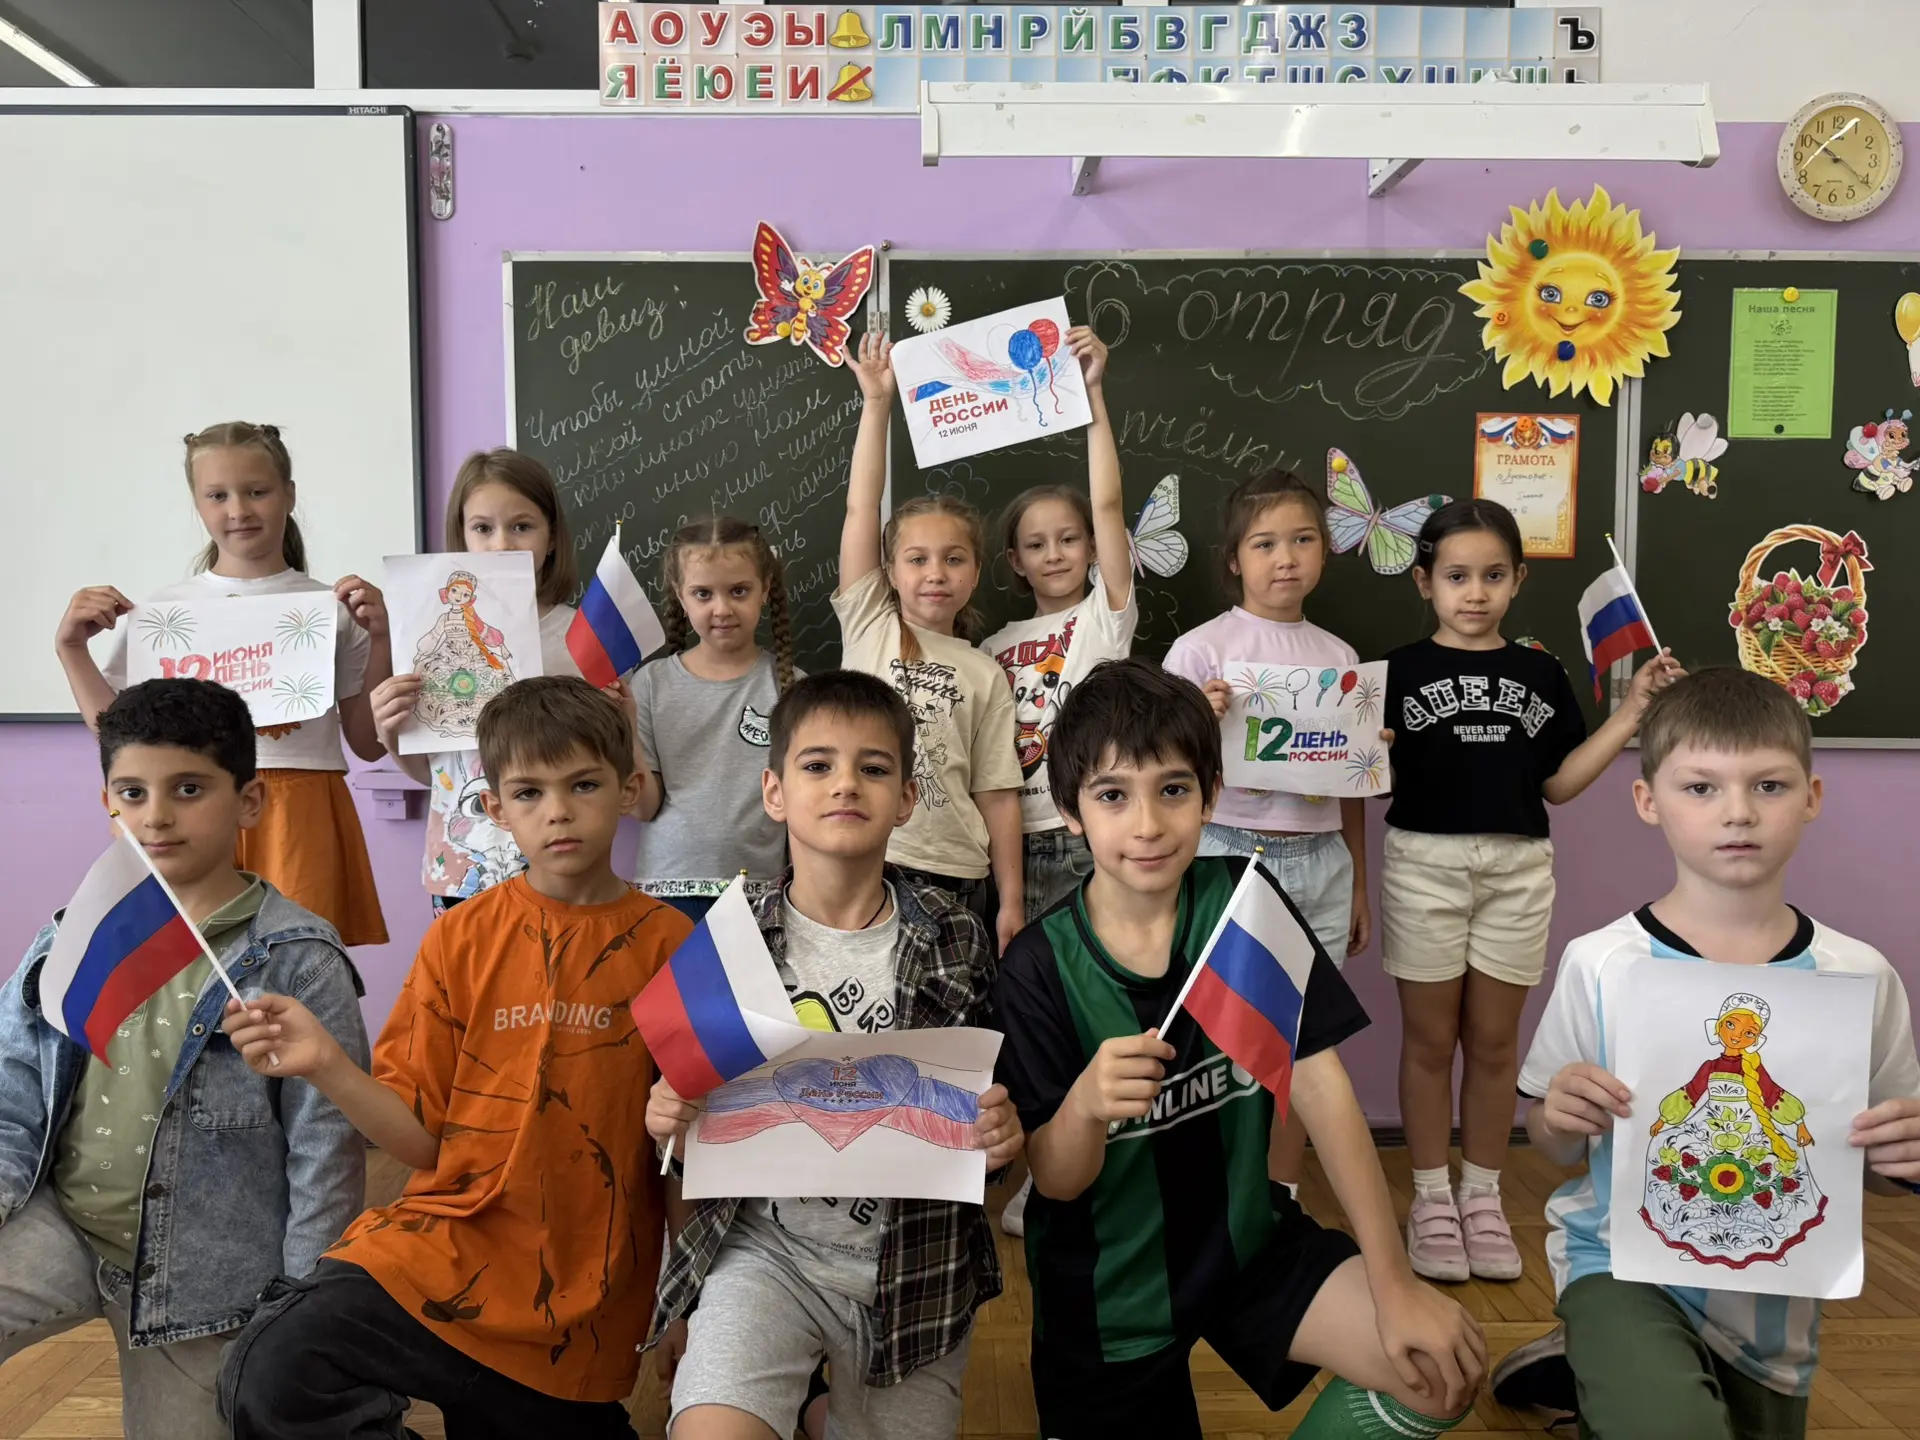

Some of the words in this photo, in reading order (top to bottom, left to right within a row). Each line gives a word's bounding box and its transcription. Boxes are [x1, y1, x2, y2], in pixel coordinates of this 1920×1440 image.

[348, 106, 386, 114] HITACHI
[1816, 120, 1824, 134] 11
[1833, 115, 1845, 130] 12
[1800, 134, 1812, 148] 10
[1864, 135, 1874, 150] 2
[1794, 151, 1803, 166] 9
[1868, 153, 1877, 168] 3
[1798, 169, 1808, 184] 8
[1813, 184, 1822, 198] 7
[1828, 188, 1837, 203] 6
[1846, 185, 1856, 199] 5
[526, 276, 624, 341] Наш
[1748, 304, 1779, 314] Наша
[1782, 305, 1815, 313] песня
[1178, 287, 1464, 406] отряд
[525, 381, 623, 447] Чтобы
[631, 308, 735, 411] умной
[929, 391, 979, 414] ДЕНЬ
[932, 398, 1009, 427] РОССИИ
[938, 429, 949, 438] 12
[949, 422, 978, 437] ИЮНЯ
[1497, 454, 1556, 466] ГРАМОТА
[213, 641, 273, 667] ИЮНЯ
[214, 659, 271, 684] ДЕНЬ
[1403, 675, 1555, 738] QUEEN
[741, 723, 769, 742] MEO
[1453, 725, 1484, 735] NEVER
[1486, 725, 1511, 735] STOP
[1244, 715, 1293, 761] 12
[1290, 730, 1348, 748] ДЕНЬ
[1461, 734, 1506, 742] DREAMING
[1289, 749, 1348, 762] РОССИИ
[494, 999, 611, 1031] BRANDING
[832, 1066, 857, 1080] 12
[799, 1088, 833, 1098] День
[836, 1088, 885, 1099] России
